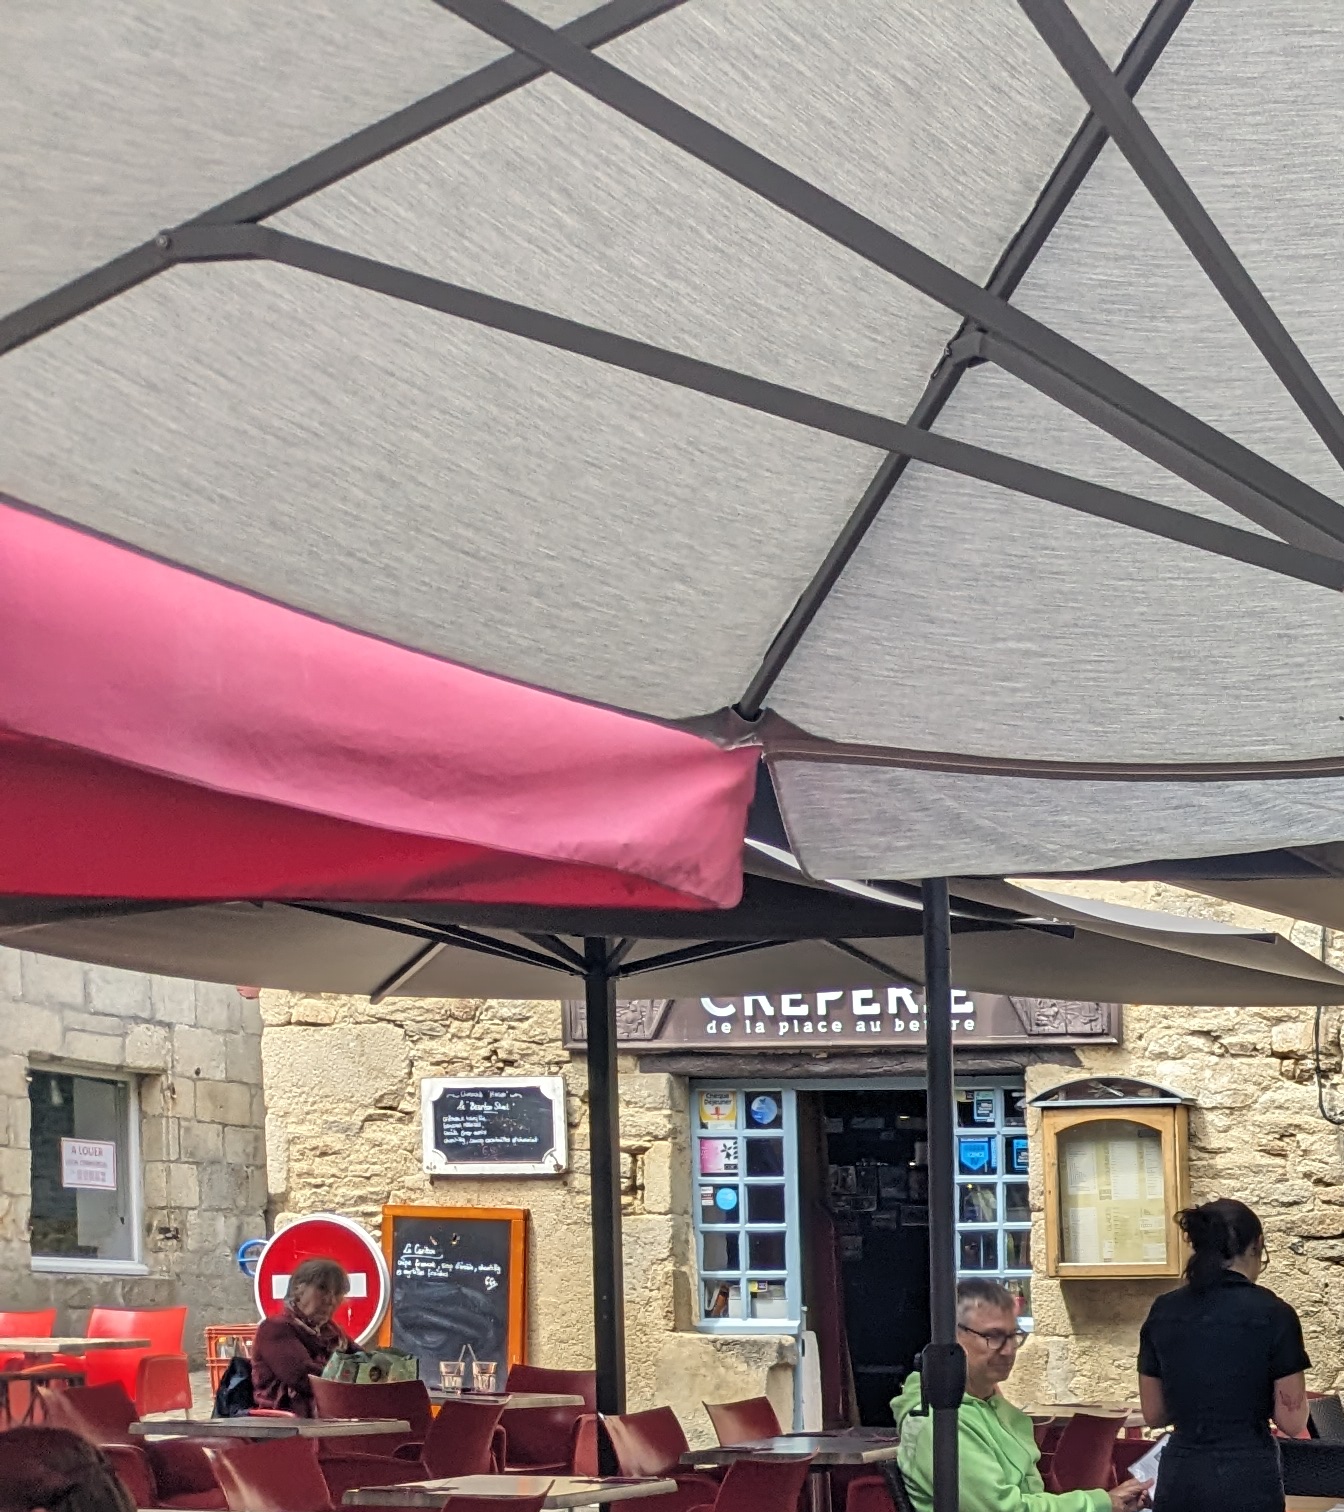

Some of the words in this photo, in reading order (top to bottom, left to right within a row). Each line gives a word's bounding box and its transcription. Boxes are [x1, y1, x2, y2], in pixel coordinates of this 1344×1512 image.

[706, 1020, 732, 1034] de
[745, 1019, 766, 1033] la
[779, 1019, 843, 1036] place
[855, 1020, 881, 1032] au
[894, 1018, 975, 1032] bere
